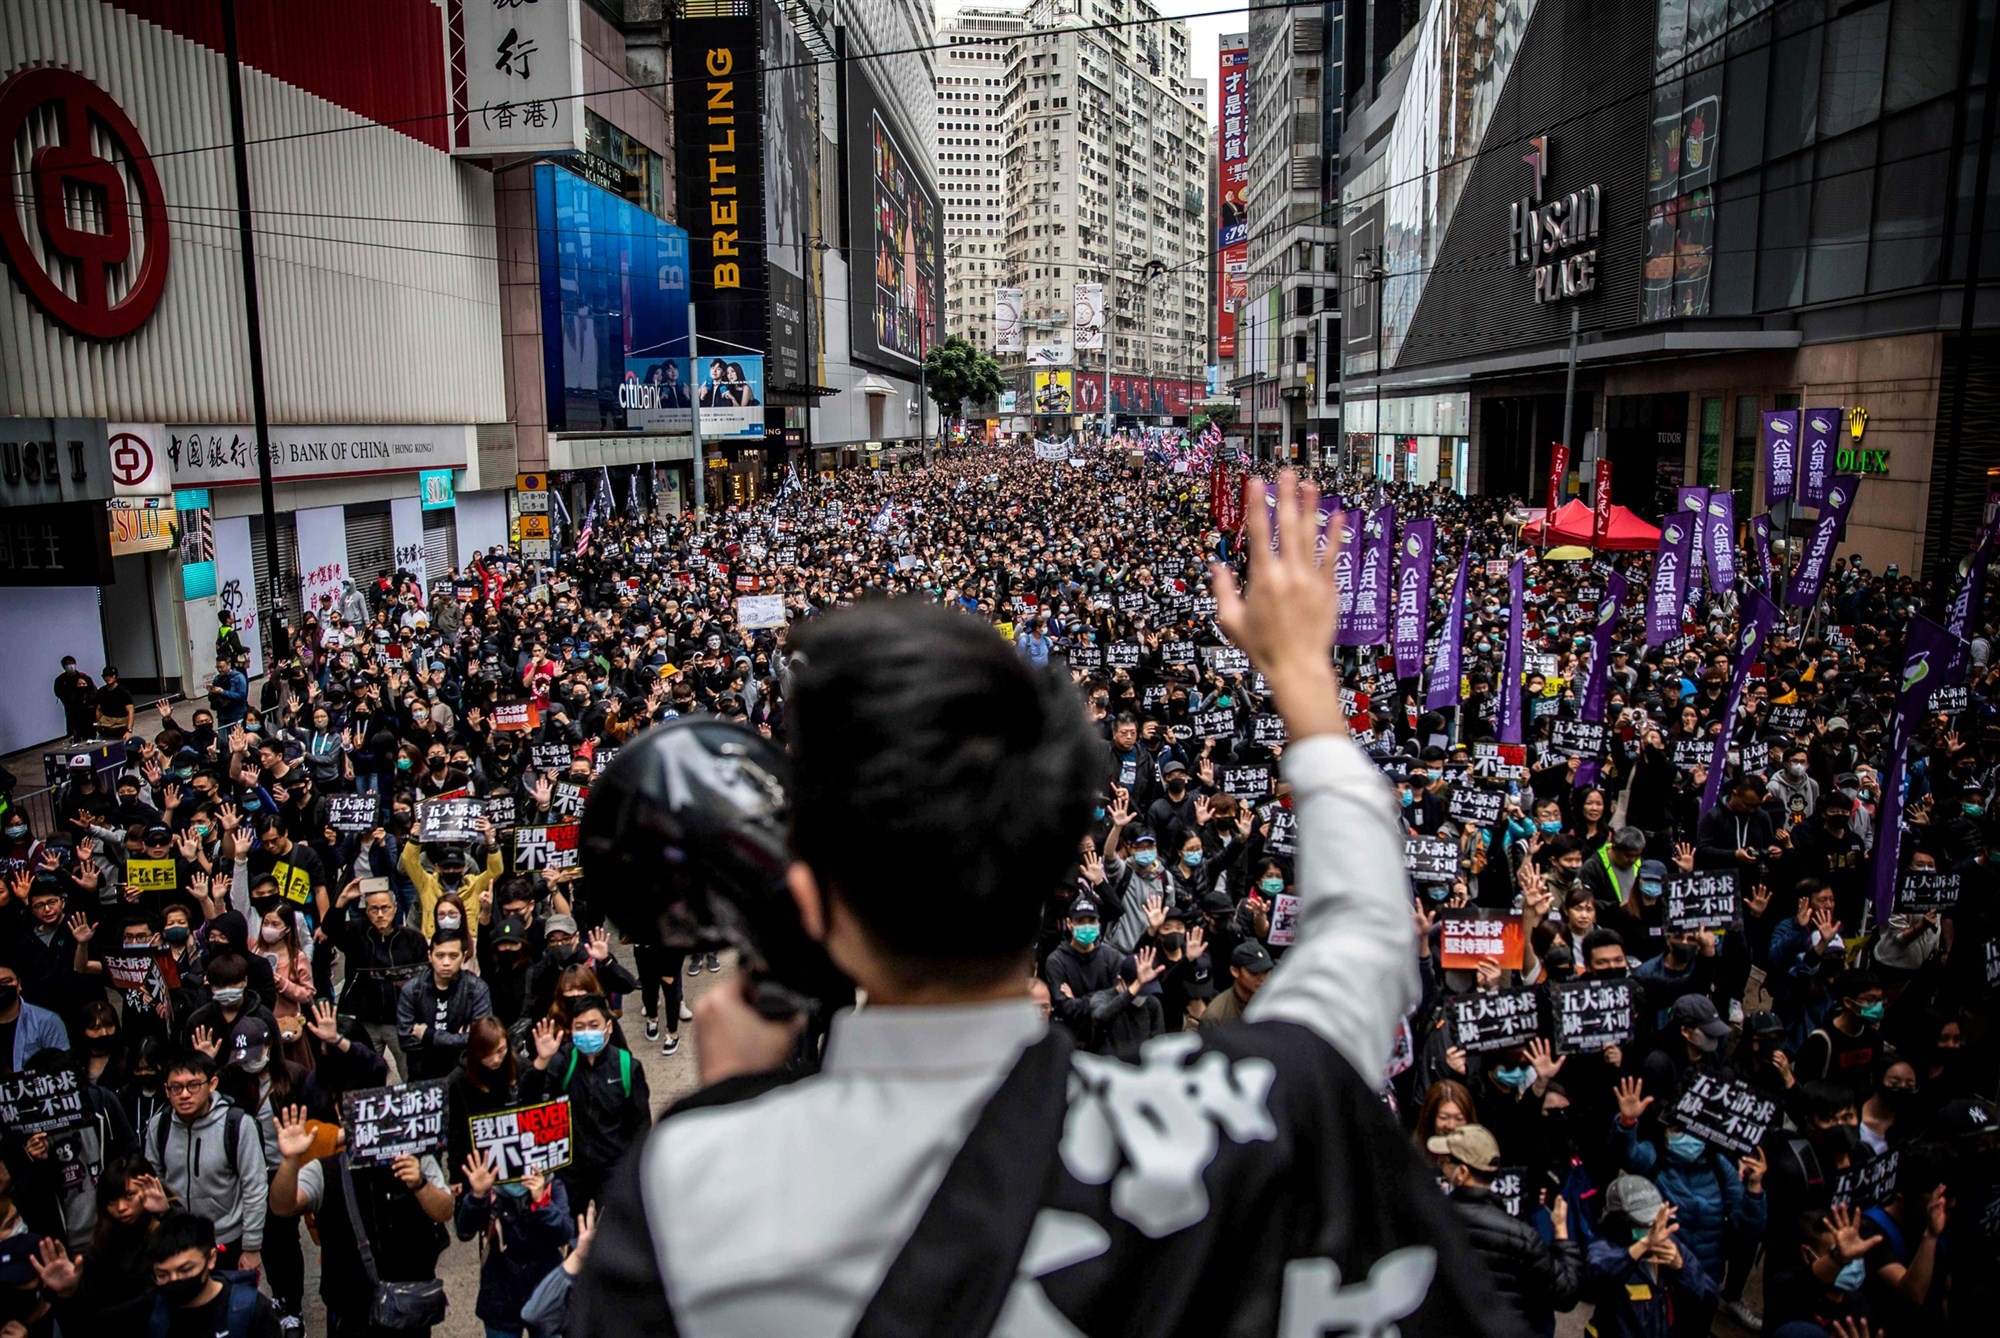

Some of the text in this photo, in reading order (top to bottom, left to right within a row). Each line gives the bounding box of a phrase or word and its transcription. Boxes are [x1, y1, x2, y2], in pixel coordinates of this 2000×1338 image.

[483, 98, 558, 131] (香港)
[597, 158, 608, 176] FOR
[609, 165, 621, 183] EVER
[706, 48, 741, 290] BREITLING
[1509, 184, 1600, 279] Hysan
[1535, 250, 1596, 304] PLACE
[618, 379, 662, 409] citibank
[1658, 432, 1681, 443] TUDOR
[291, 443, 328, 463] BANK
[331, 443, 347, 460] OF
[351, 441, 390, 459] CHINA
[392, 443, 414, 456] (HONG
[415, 441, 434, 455] KONG)
[1070, 649, 1101, 659] 五大訴求
[1108, 645, 1139, 655] 五大訴求
[1162, 641, 1194, 652] 五大訴求
[1772, 706, 1808, 718] 五大訴求
[1928, 698, 1968, 712] 缺一不可
[1194, 710, 1233, 725] 五大訴求
[1194, 720, 1234, 735] 缺一不可
[1553, 721, 1602, 738] 五大訴求
[532, 744, 570, 756] 五大訴求
[1475, 745, 1497, 756] 我們
[1552, 734, 1601, 751] 缺一不可
[1676, 741, 1714, 751] 五大訴求
[532, 755, 571, 767] 缺一不可
[1673, 751, 1713, 763] 缺一不可
[1224, 768, 1268, 780] 五大訴求
[558, 783, 581, 796] 我們
[1224, 779, 1268, 792] 缺一不可
[330, 797, 376, 811] 五大訴求
[1452, 789, 1500, 806] 五大訴求
[329, 811, 374, 823] 缺一不可
[427, 803, 482, 817] 五大訴求
[1450, 802, 1499, 820] 缺一不可
[517, 828, 547, 844] 我們
[1405, 840, 1458, 857] 五大訴求
[1669, 875, 1734, 898] 五大訴求
[1904, 873, 1961, 890] 五大訴求
[1901, 888, 1960, 903] 缺一不可
[1668, 895, 1734, 919] 缺一不可
[1444, 920, 1502, 937] 五大訴求
[1445, 938, 1504, 955] 堅持到底
[106, 955, 151, 971] 五大訴求
[1455, 992, 1537, 1022] 五大訴求
[1561, 987, 1630, 1013] 五大訴求
[1458, 1014, 1538, 1043] 缺一不可
[1562, 1010, 1630, 1036] 缺一不可
[0, 1070, 78, 1101] 五大訴求
[355, 1087, 443, 1123] 五大訴求
[1690, 1073, 1776, 1123] 五大訴求
[1, 1091, 81, 1123] 缺一不可
[1968, 1105, 1988, 1124] NY
[517, 1102, 569, 1131] NEVER
[1676, 1091, 1767, 1145] 缺一不可
[355, 1110, 443, 1149] 缺一不可
[472, 1112, 519, 1141] 我們
